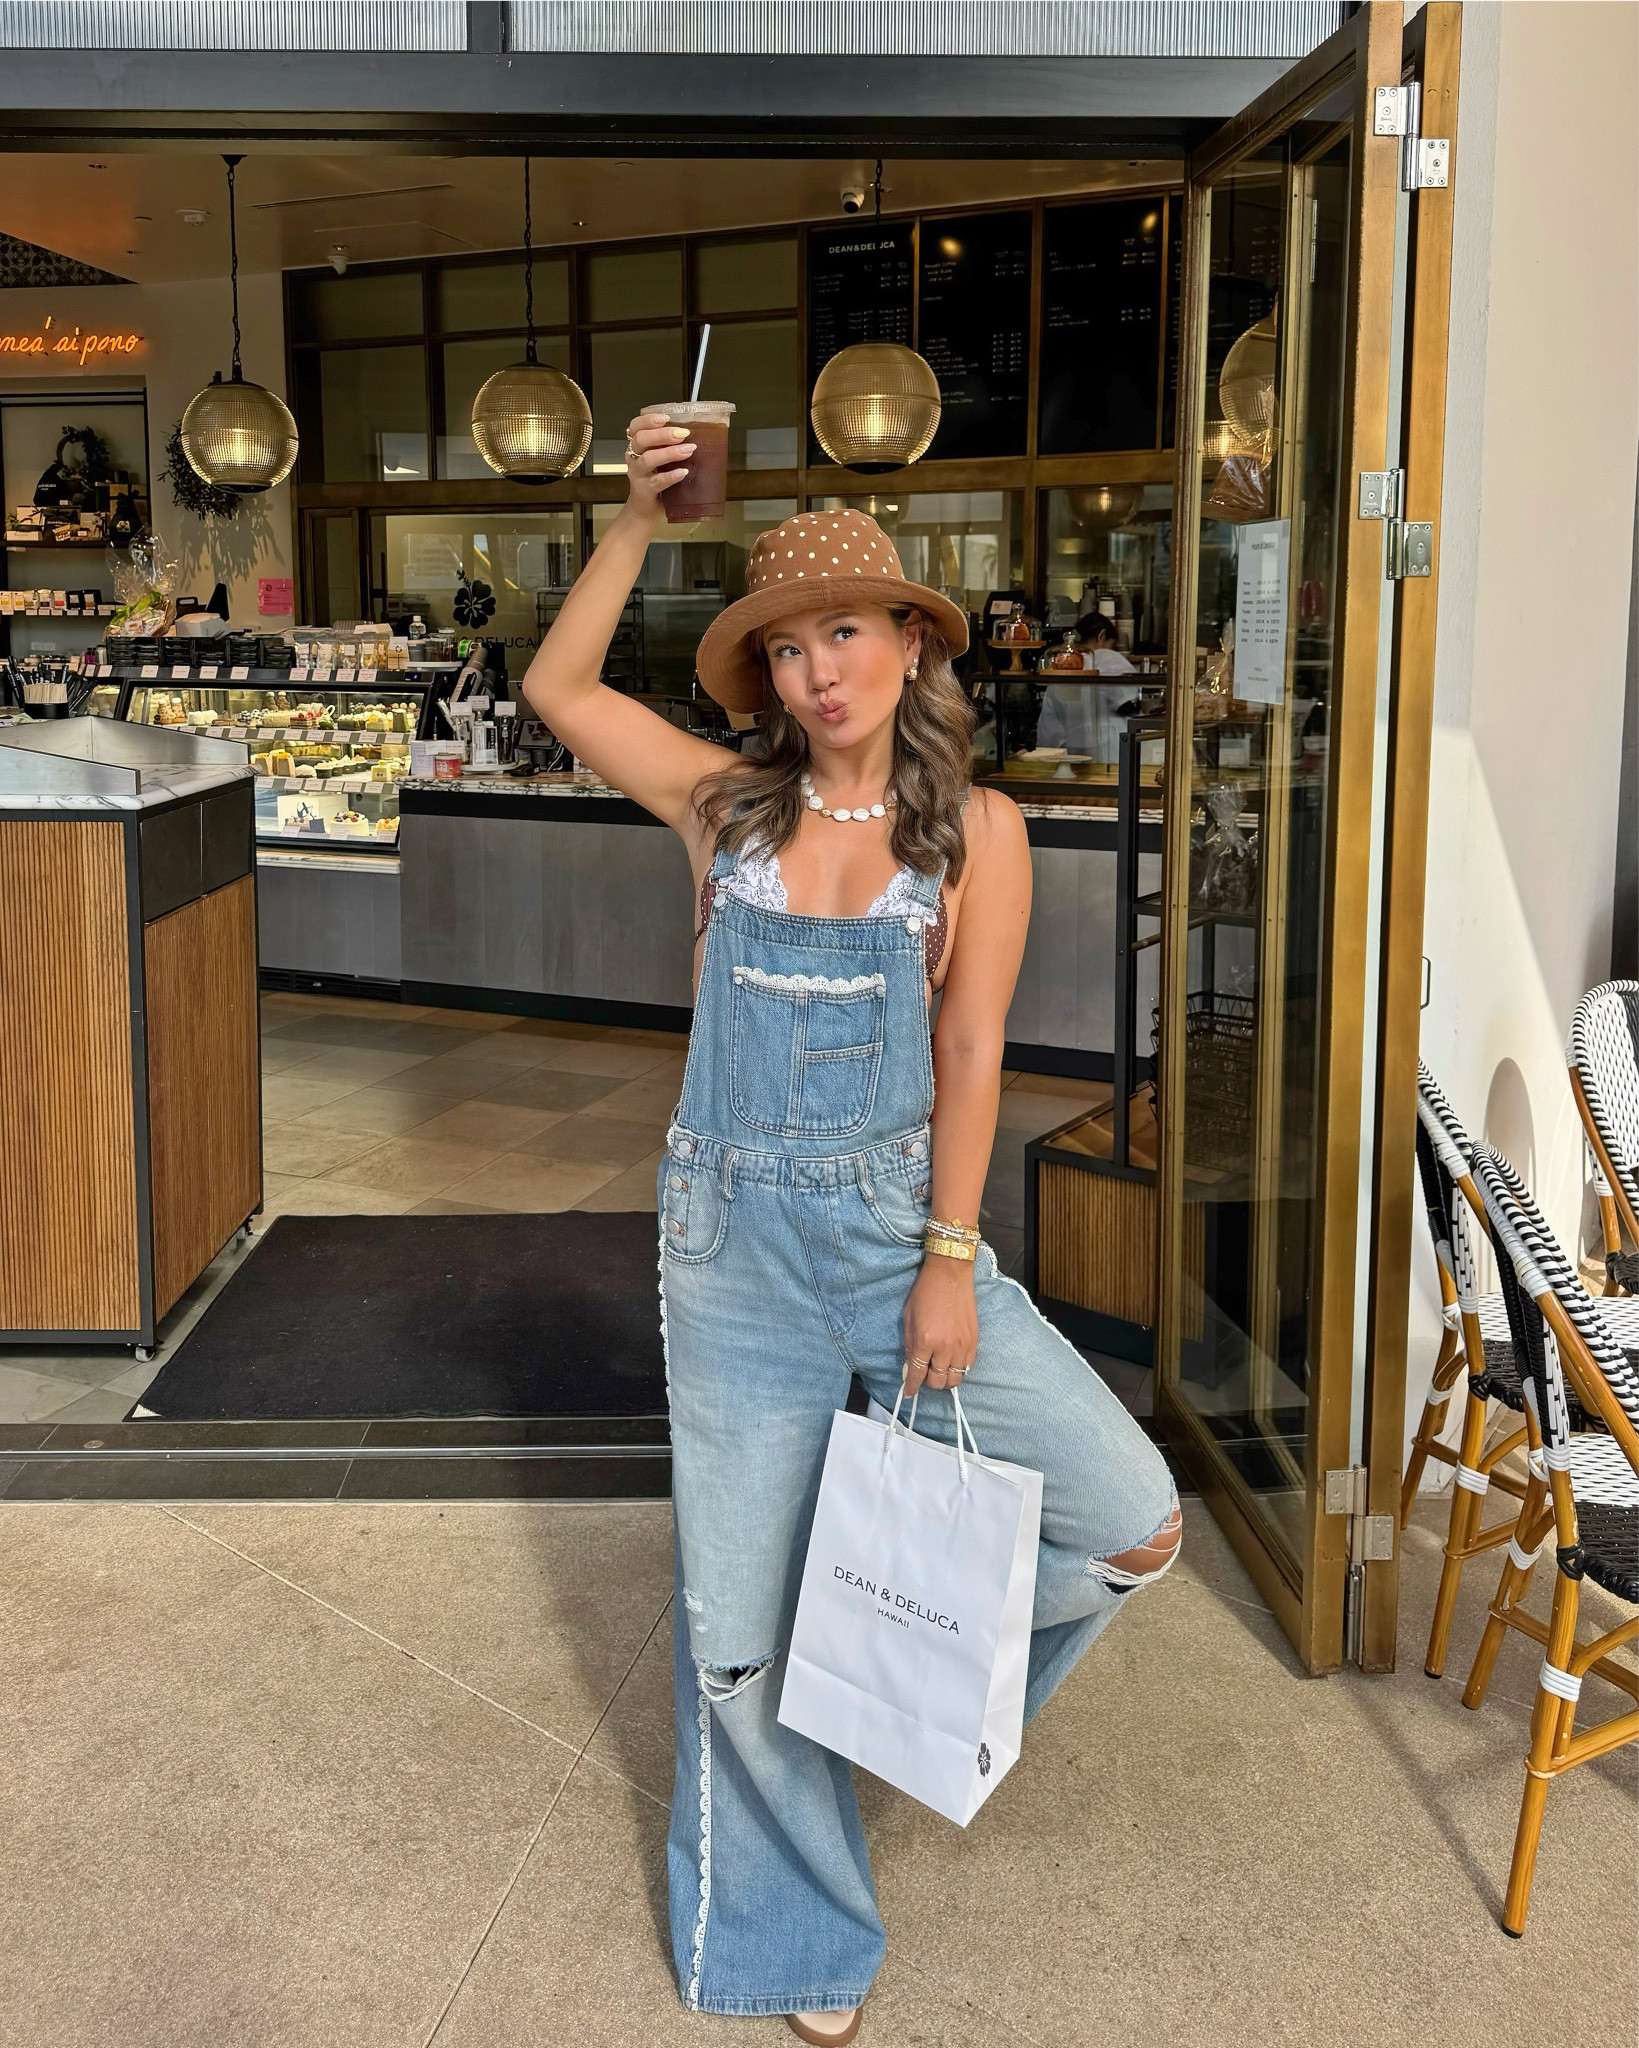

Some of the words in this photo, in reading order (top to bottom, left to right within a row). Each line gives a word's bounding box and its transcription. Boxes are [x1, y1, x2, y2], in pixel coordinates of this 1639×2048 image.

[79, 335, 139, 366] pono
[834, 1566, 877, 1595] DEAN
[880, 1588, 891, 1602] &
[895, 1594, 960, 1635] DELUCA
[877, 1607, 910, 1628] HAWAII
